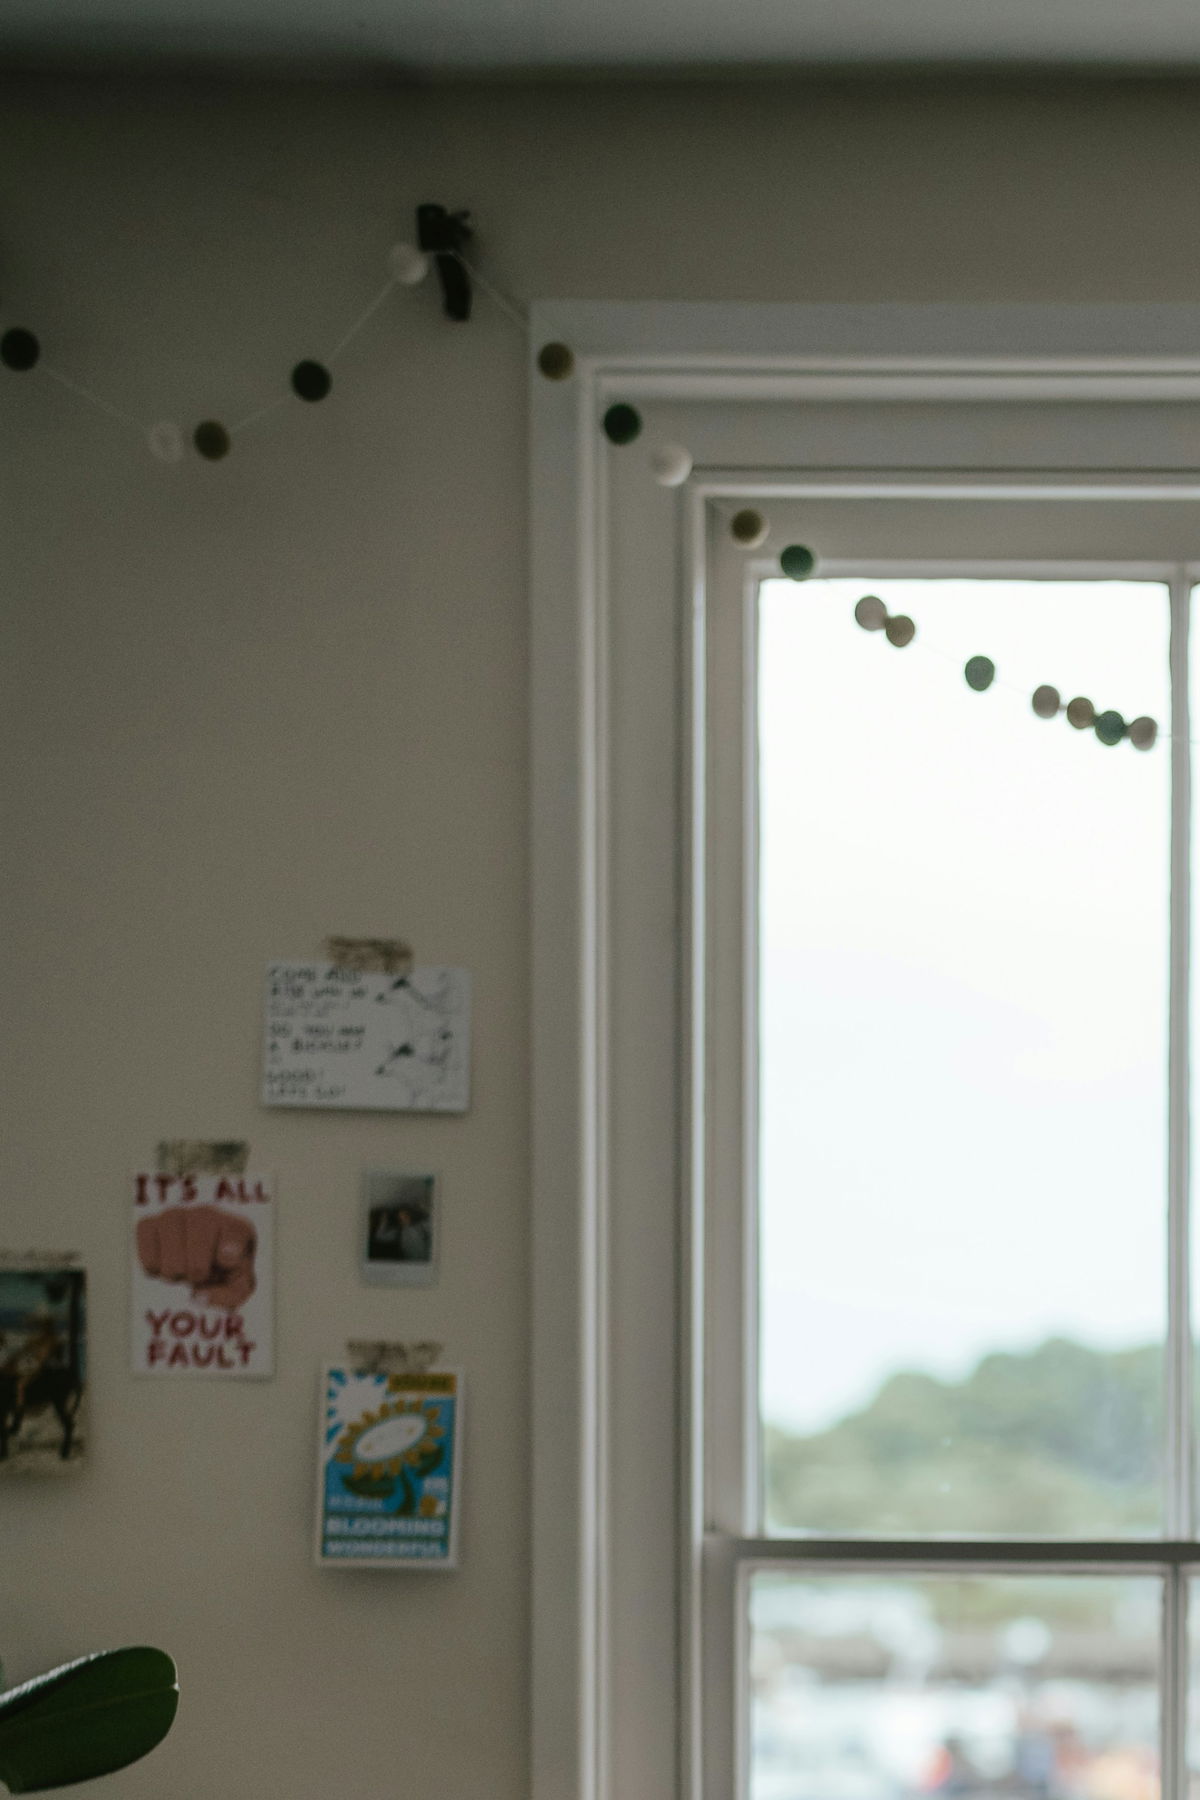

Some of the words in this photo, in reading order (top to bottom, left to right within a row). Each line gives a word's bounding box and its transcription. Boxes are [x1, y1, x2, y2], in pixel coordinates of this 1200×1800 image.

[215, 1177, 269, 1204] ALL
[145, 1308, 245, 1341] YOUR
[147, 1340, 256, 1368] FAULT
[326, 1518, 445, 1536] BLOOMING
